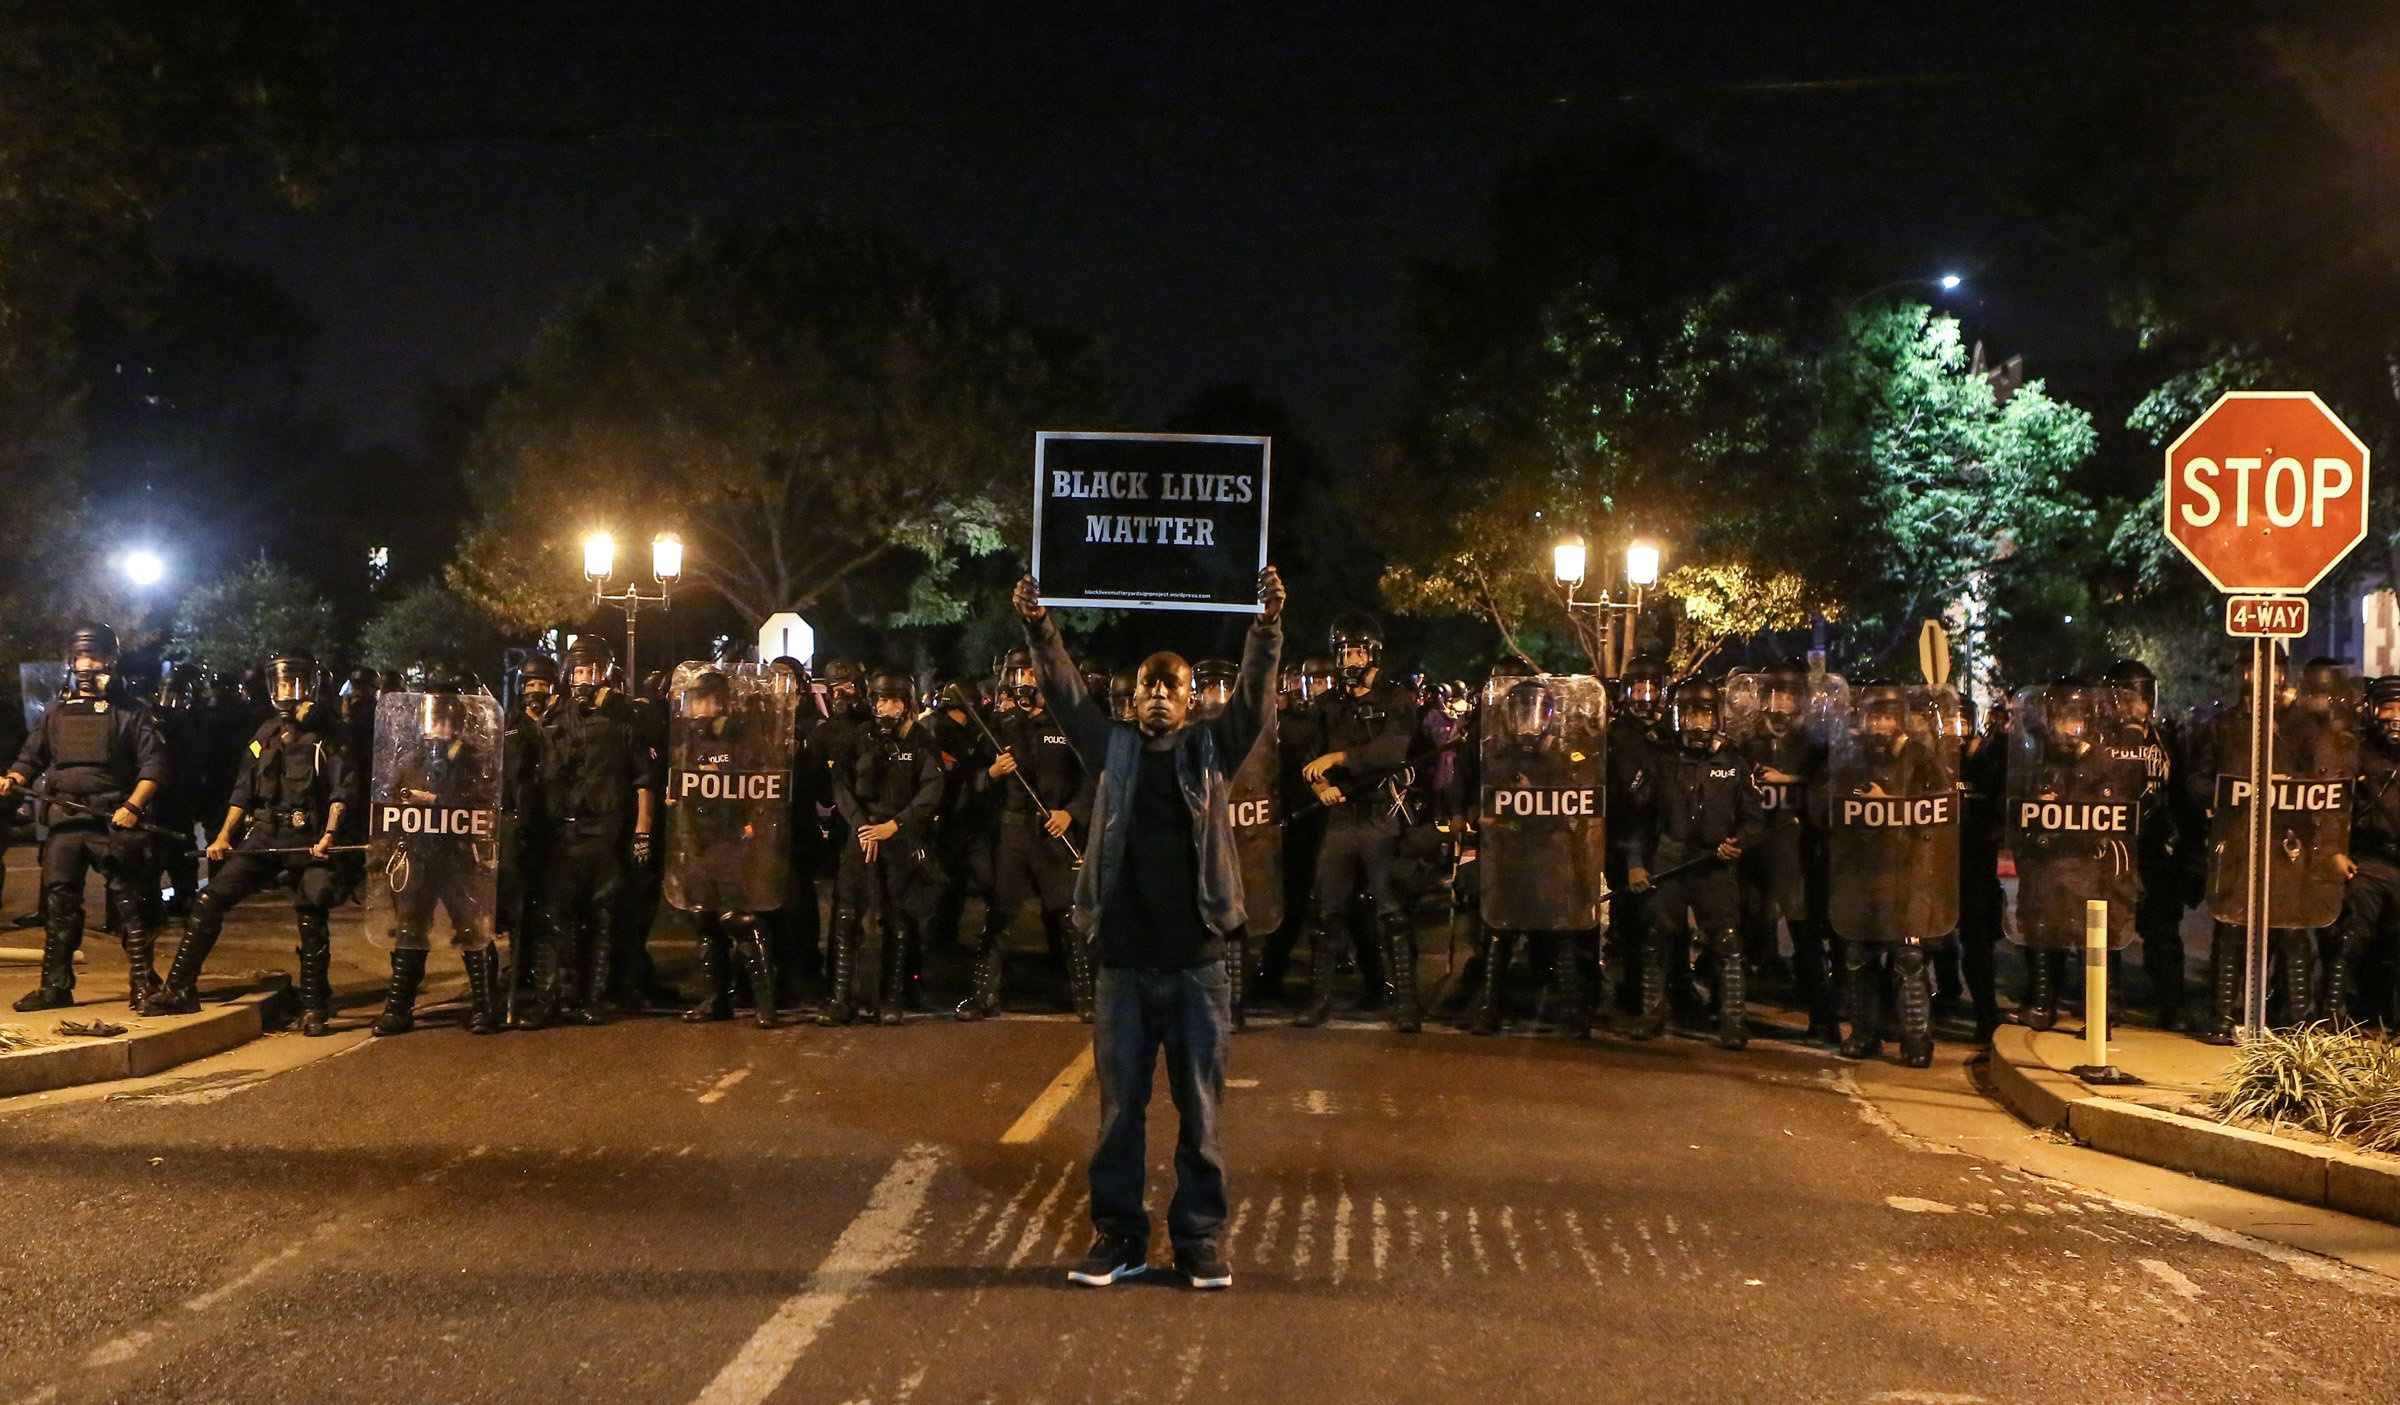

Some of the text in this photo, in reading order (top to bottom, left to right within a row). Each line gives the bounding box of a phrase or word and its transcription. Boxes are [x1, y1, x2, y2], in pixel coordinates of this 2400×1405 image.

[1051, 470, 1252, 503] BLACK LIVES
[2181, 457, 2353, 528] STOP
[1085, 515, 1215, 546] MATTER
[1084, 589, 1211, 599] blacklivesmatteryardsignproject.wordpress.com
[2233, 605, 2302, 628] 4-WAY
[1043, 735, 1067, 744] POLICE
[682, 772, 781, 799] POLICE
[2231, 780, 2343, 810] PLICE
[1228, 799, 1270, 828] ICE
[1495, 790, 1594, 815] POLICE
[1844, 798, 1948, 826] POLICE
[2021, 802, 2128, 831] POLICE
[383, 806, 487, 835] POLICE
